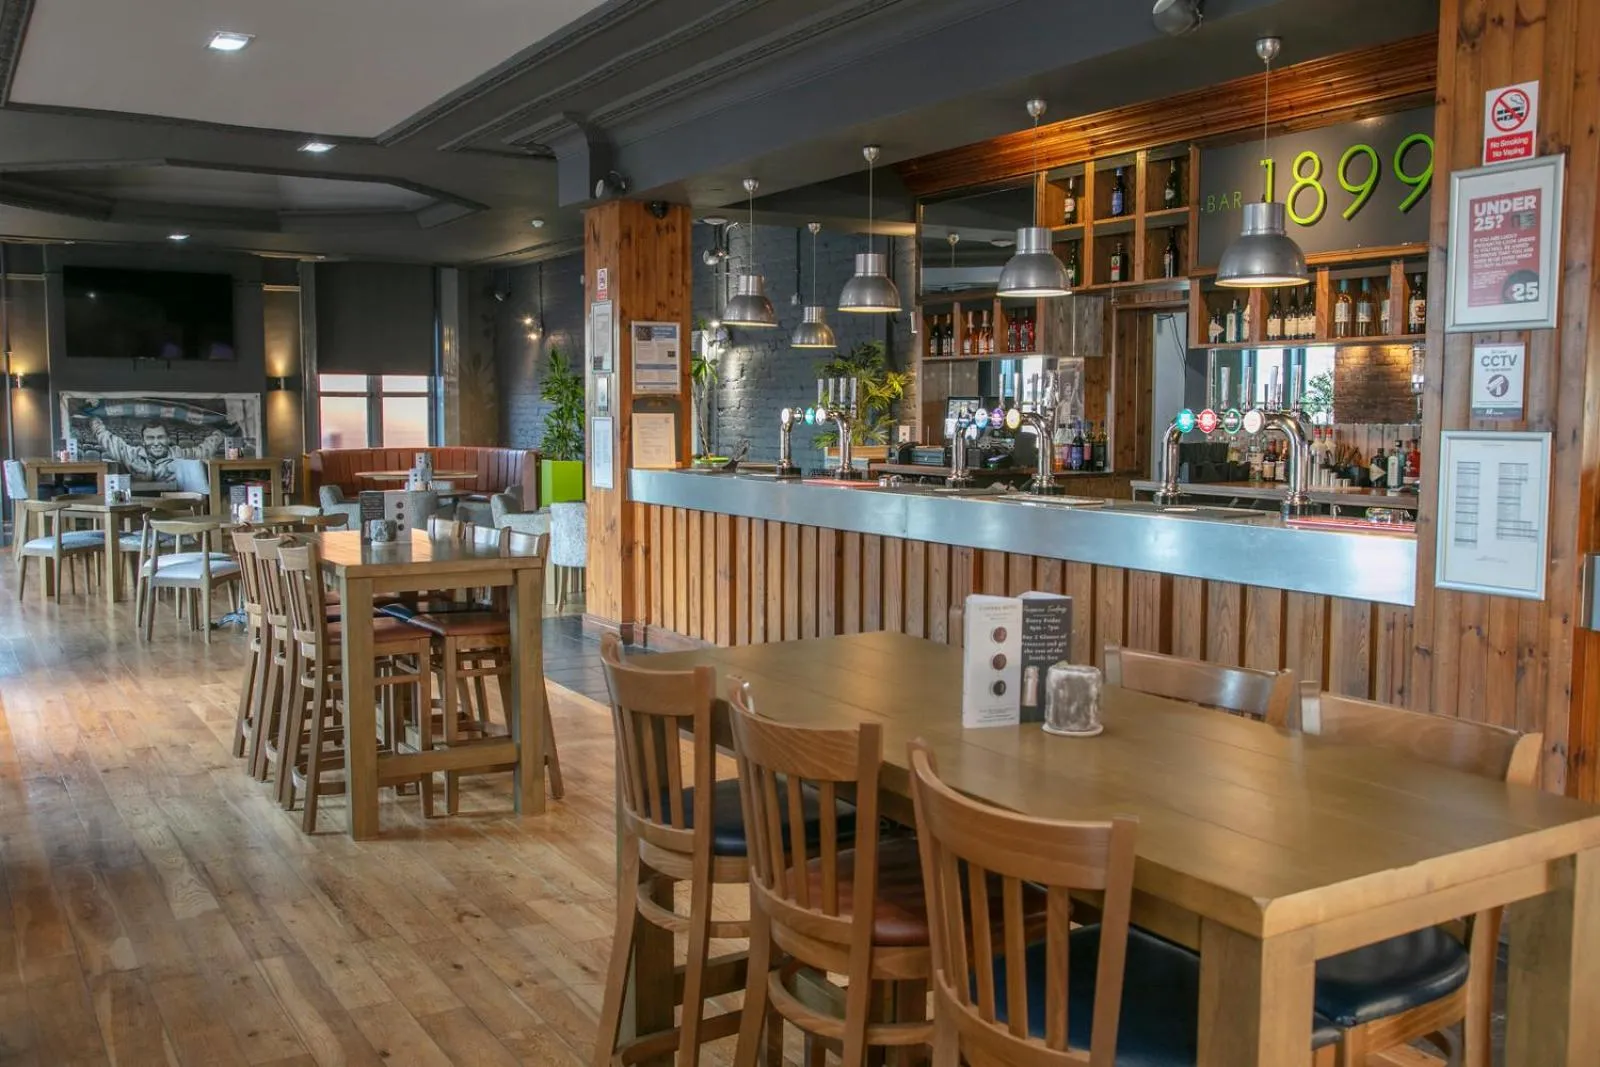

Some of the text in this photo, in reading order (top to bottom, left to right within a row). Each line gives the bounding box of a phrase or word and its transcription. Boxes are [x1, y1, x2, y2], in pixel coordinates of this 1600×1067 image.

[1500, 137, 1528, 147] Smoking
[1503, 147, 1524, 156] Vaping
[1207, 134, 1434, 225] BAR 1899
[1474, 195, 1537, 217] UNDER
[1474, 214, 1504, 232] 25?
[1512, 281, 1538, 301] 25
[1481, 354, 1518, 367] CCTV
